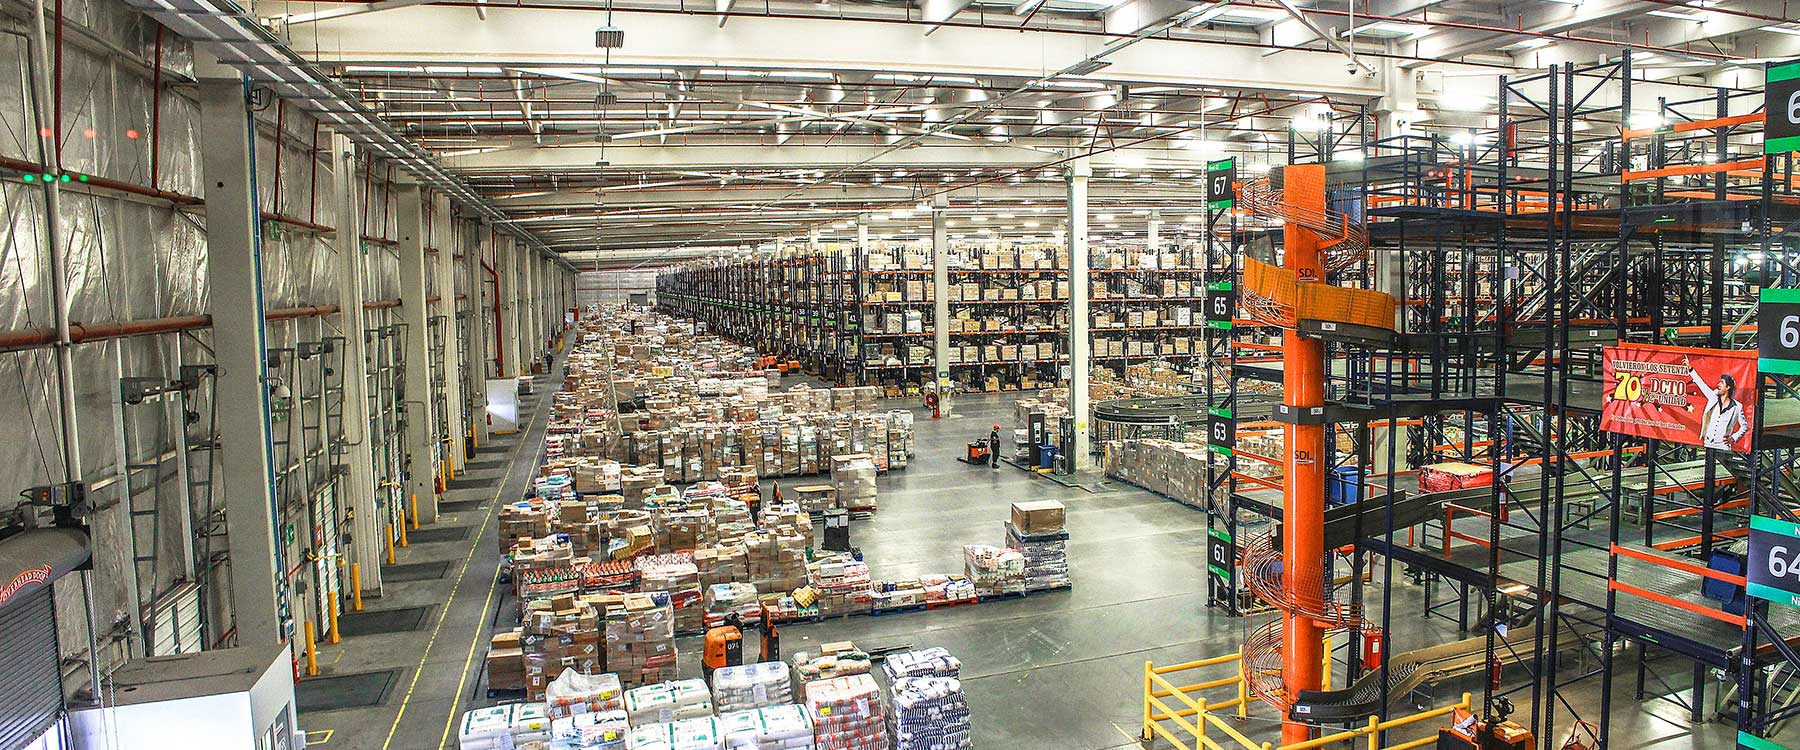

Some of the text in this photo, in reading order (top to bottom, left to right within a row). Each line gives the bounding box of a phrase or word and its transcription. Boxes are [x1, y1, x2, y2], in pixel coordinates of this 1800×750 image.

[1214, 176, 1227, 195] 67
[1214, 297, 1227, 315] 65
[1612, 360, 1689, 375] VOLVIERON LOS SETENTA
[1214, 422, 1226, 441] 63
[1214, 544, 1226, 564] 61
[1768, 545, 1800, 582] 64
[3, 572, 32, 601] OVERHEAD
